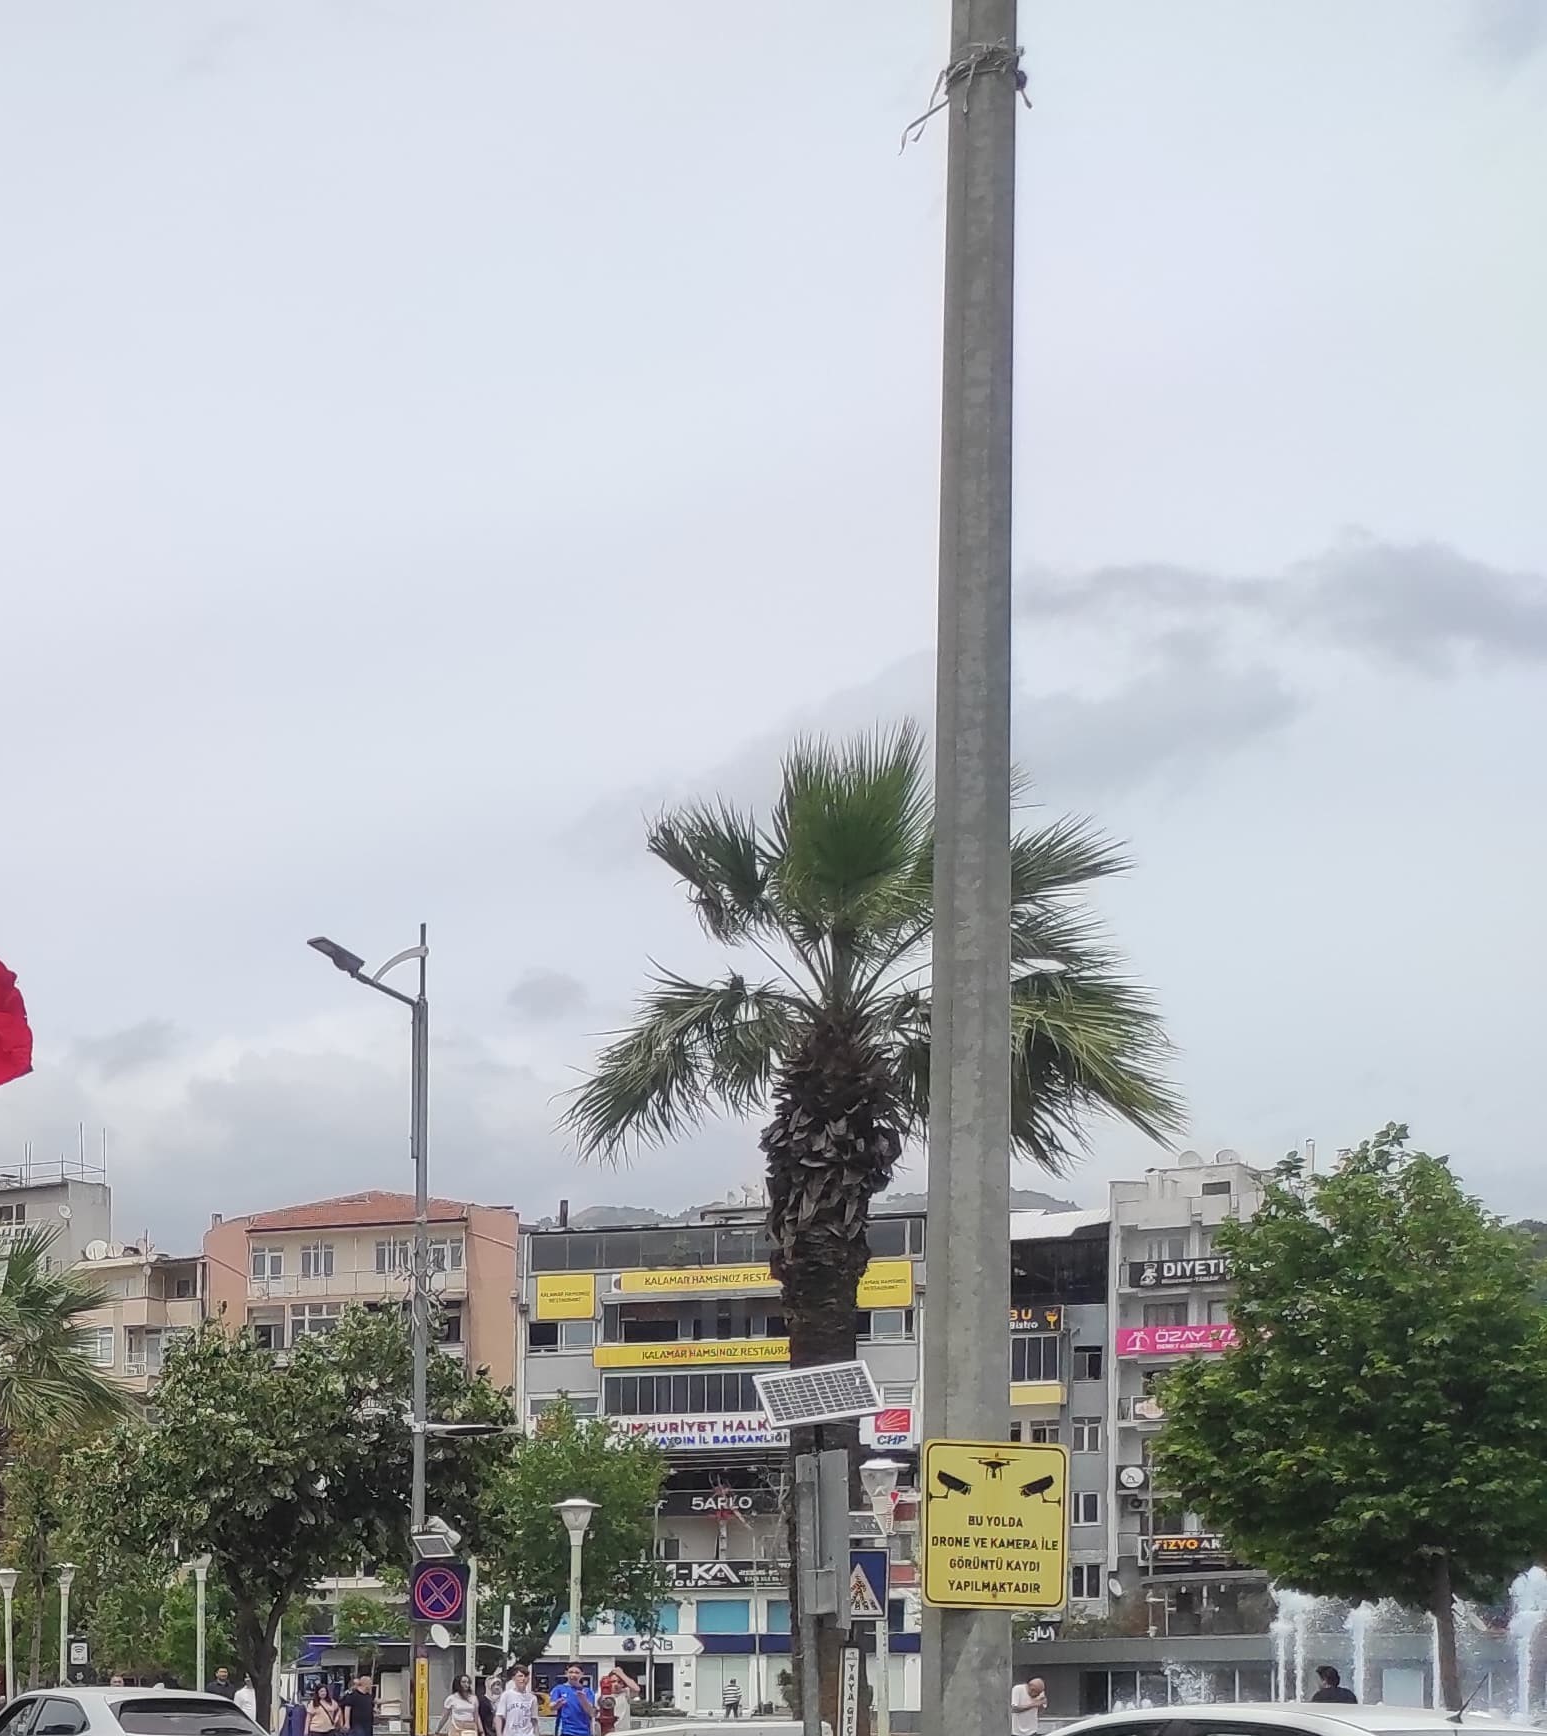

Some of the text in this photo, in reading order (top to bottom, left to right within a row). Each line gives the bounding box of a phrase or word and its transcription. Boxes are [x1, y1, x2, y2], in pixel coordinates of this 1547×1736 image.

[644, 1276, 690, 1286] KALAMAR
[1155, 1329, 1206, 1343] ÖZAY
[642, 1349, 688, 1360] KALAMAR
[876, 1434, 907, 1446] CHP
[968, 1515, 1023, 1528] BU YOLDA
[931, 1535, 1059, 1551] DRONE VE KAMERA İLE
[949, 1556, 1041, 1573] GÖRÜNTÜ KAYDI
[948, 1579, 1041, 1594] YAPILMAKTADIR
